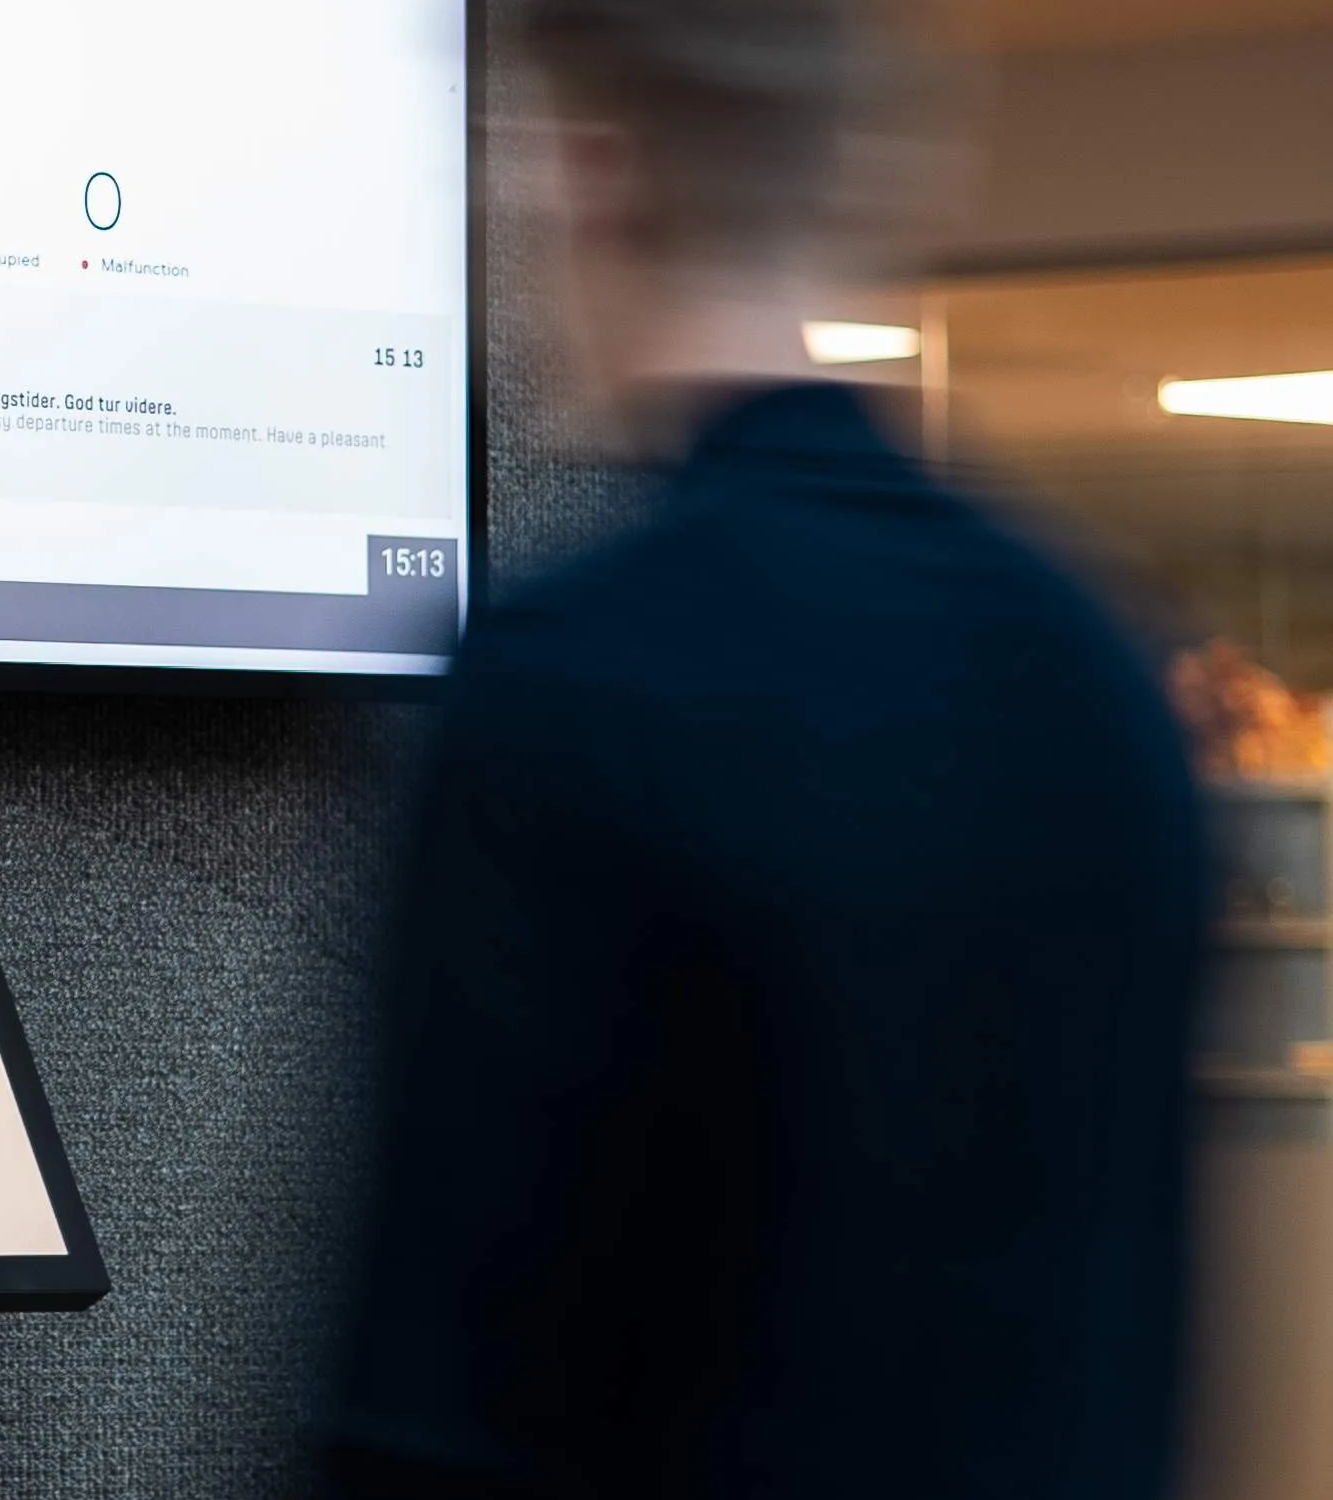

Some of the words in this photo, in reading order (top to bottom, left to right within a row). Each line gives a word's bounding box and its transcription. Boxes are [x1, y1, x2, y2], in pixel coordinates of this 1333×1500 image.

[84, 172, 121, 230] 0
[101, 259, 189, 278] Malfunction
[64, 395, 94, 412] God
[98, 396, 121, 413] tur
[125, 397, 177, 416] videre.
[16, 413, 94, 433] departure
[98, 417, 141, 435] times
[146, 422, 161, 436] at
[167, 421, 191, 438] the
[195, 423, 262, 442] moment.
[267, 426, 303, 444] Have
[308, 432, 316, 445] a
[321, 431, 386, 449] pleasant
[382, 548, 445, 578] 15:13
